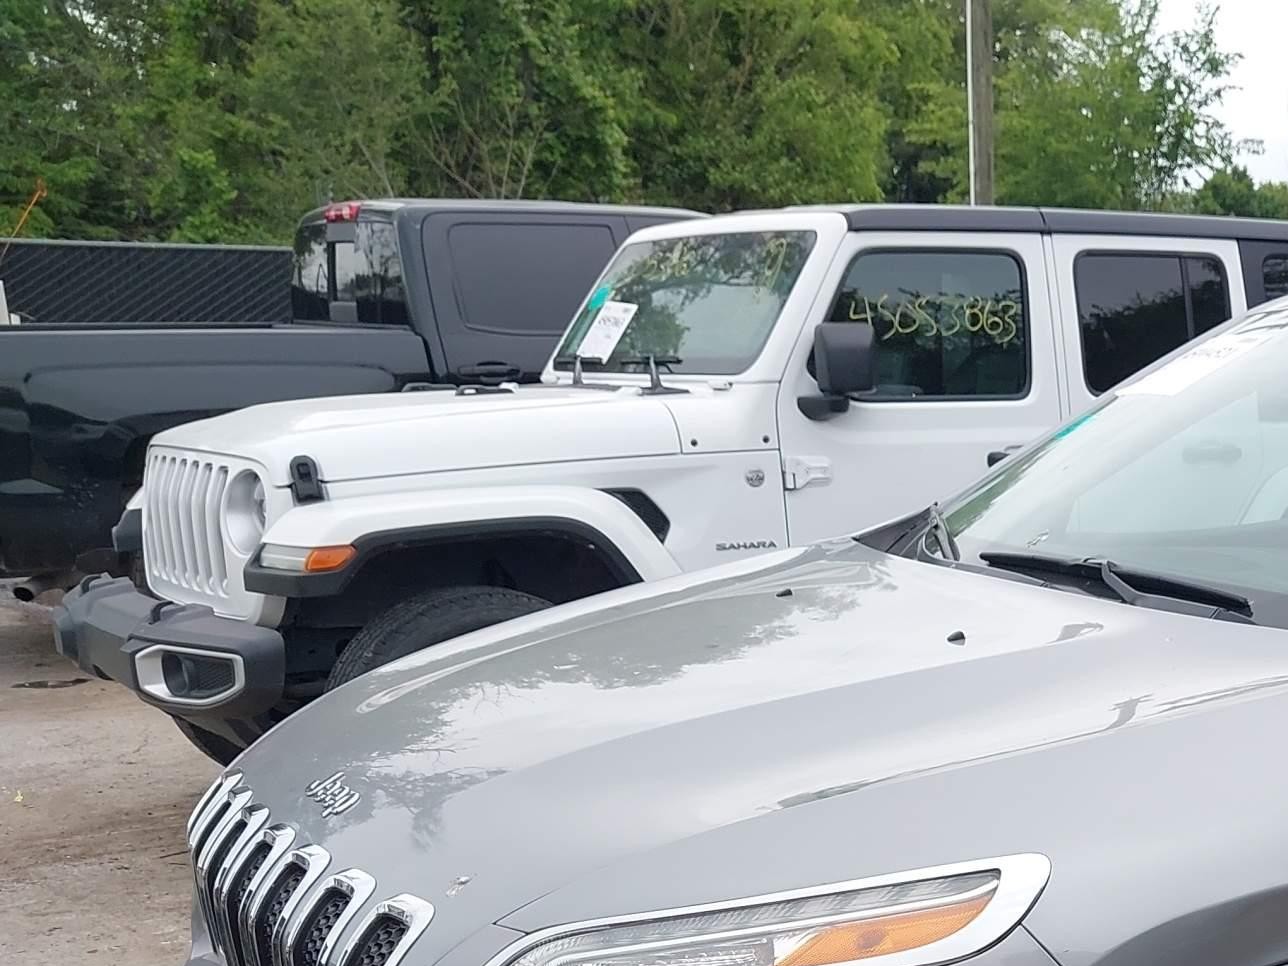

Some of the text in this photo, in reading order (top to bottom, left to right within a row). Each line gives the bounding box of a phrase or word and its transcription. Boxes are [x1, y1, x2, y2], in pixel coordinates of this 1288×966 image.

[849, 294, 1017, 344] 45053863
[715, 541, 777, 551] SAHARA
[305, 771, 360, 818] Jeep
